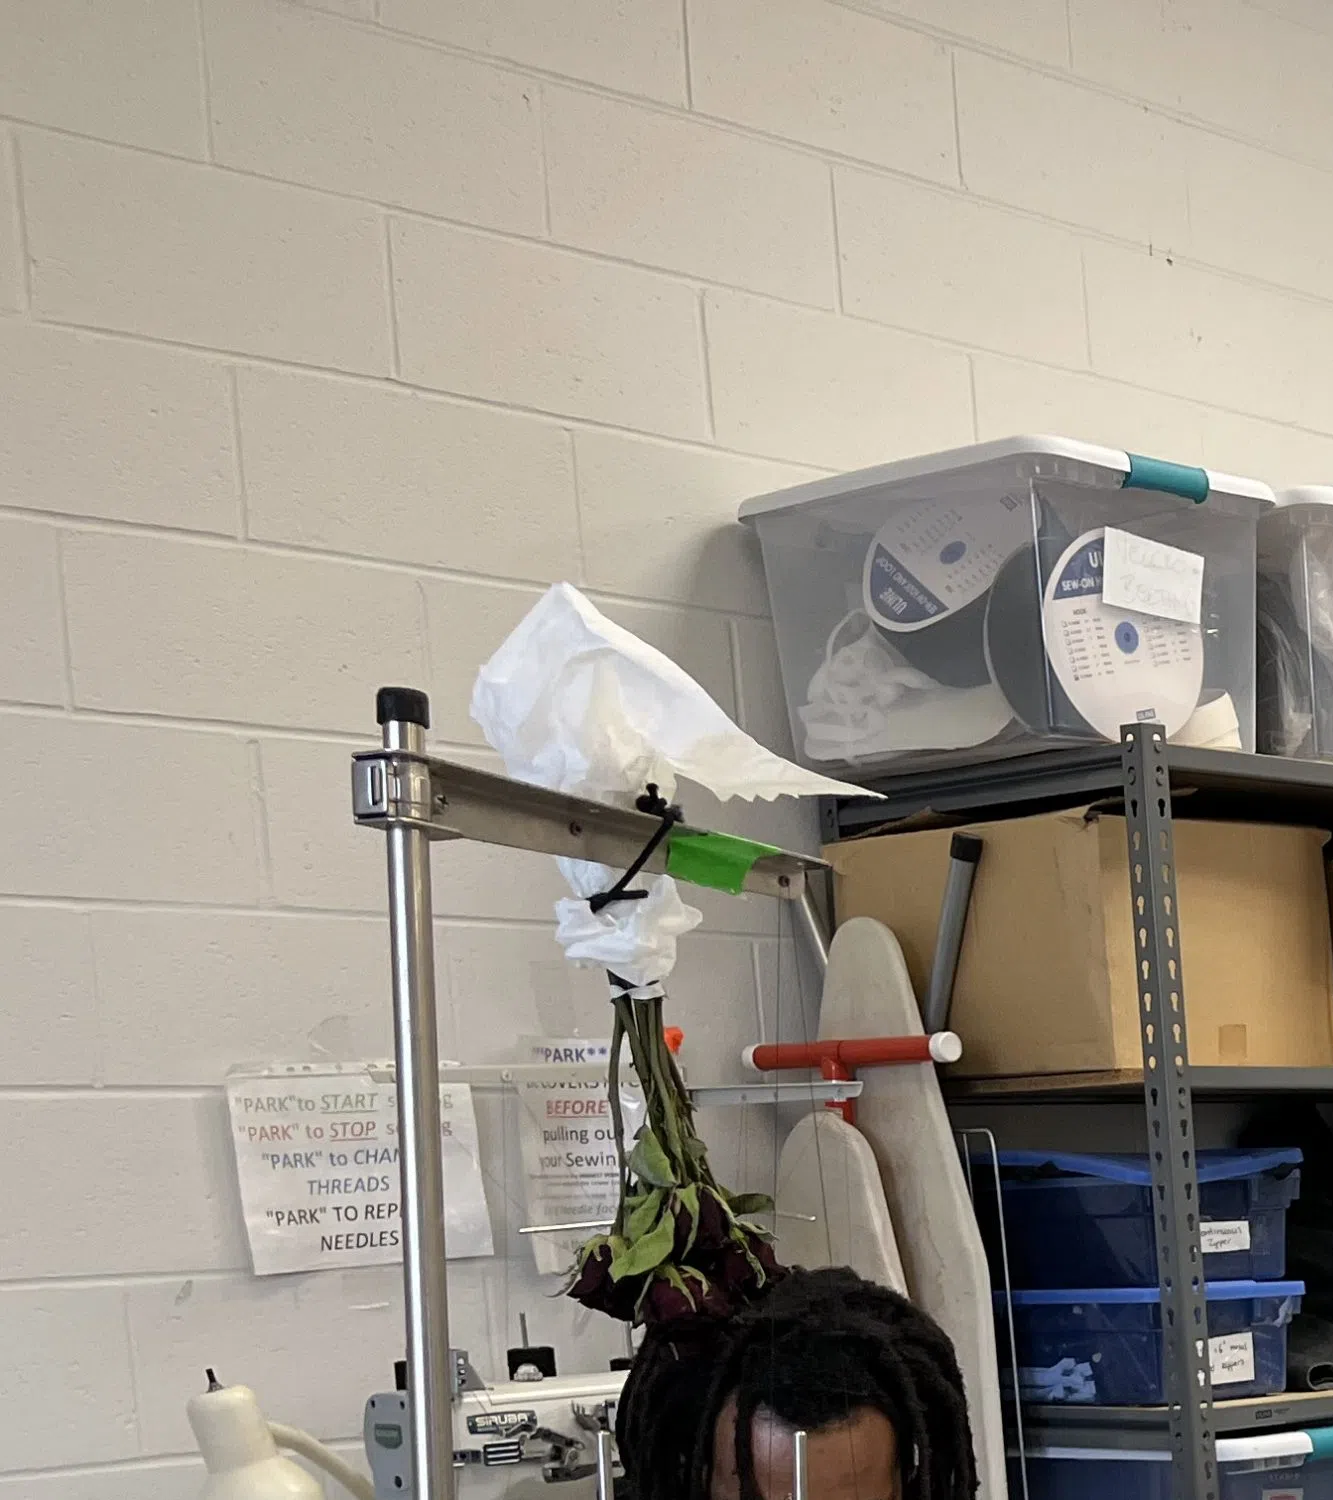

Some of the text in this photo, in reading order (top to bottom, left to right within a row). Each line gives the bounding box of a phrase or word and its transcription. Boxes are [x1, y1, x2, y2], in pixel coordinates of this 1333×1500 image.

[320, 1093, 378, 1111] START
[546, 1100, 609, 1116] BEFORE
[239, 1121, 377, 1142] "PARK" to STOP
[543, 1126, 590, 1145] pulling
[262, 1150, 323, 1170] "PARK"
[329, 1152, 348, 1167] to
[565, 1152, 617, 1167] Sewin
[308, 1176, 390, 1195] THREADS
[267, 1206, 327, 1226] "PARK"
[333, 1205, 358, 1222] TO
[321, 1230, 400, 1251] NEEDLES
